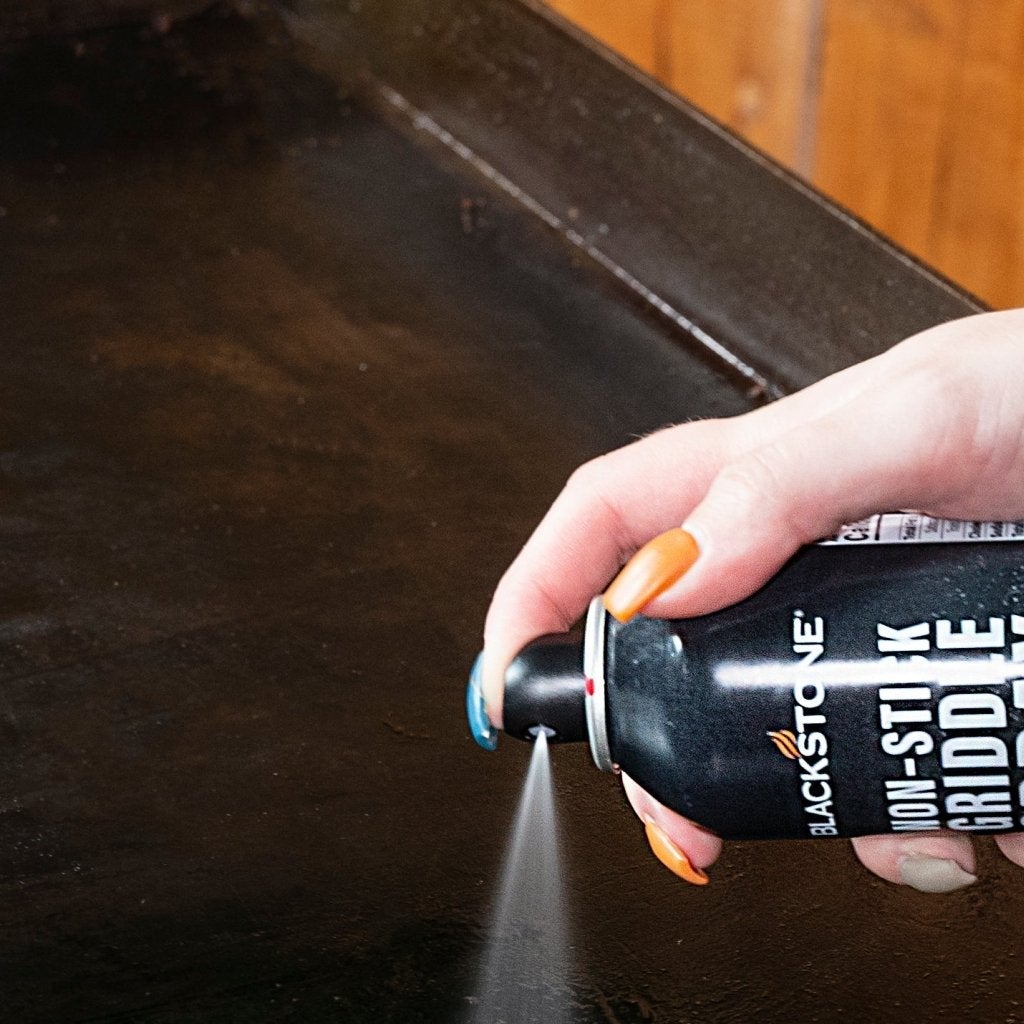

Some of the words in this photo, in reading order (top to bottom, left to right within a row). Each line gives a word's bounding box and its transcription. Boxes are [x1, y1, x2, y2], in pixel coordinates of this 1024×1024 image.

[792, 614, 839, 836] BLACKSTONE
[876, 621, 941, 831] NON-STICK
[936, 616, 1014, 832] GRIDDLE
